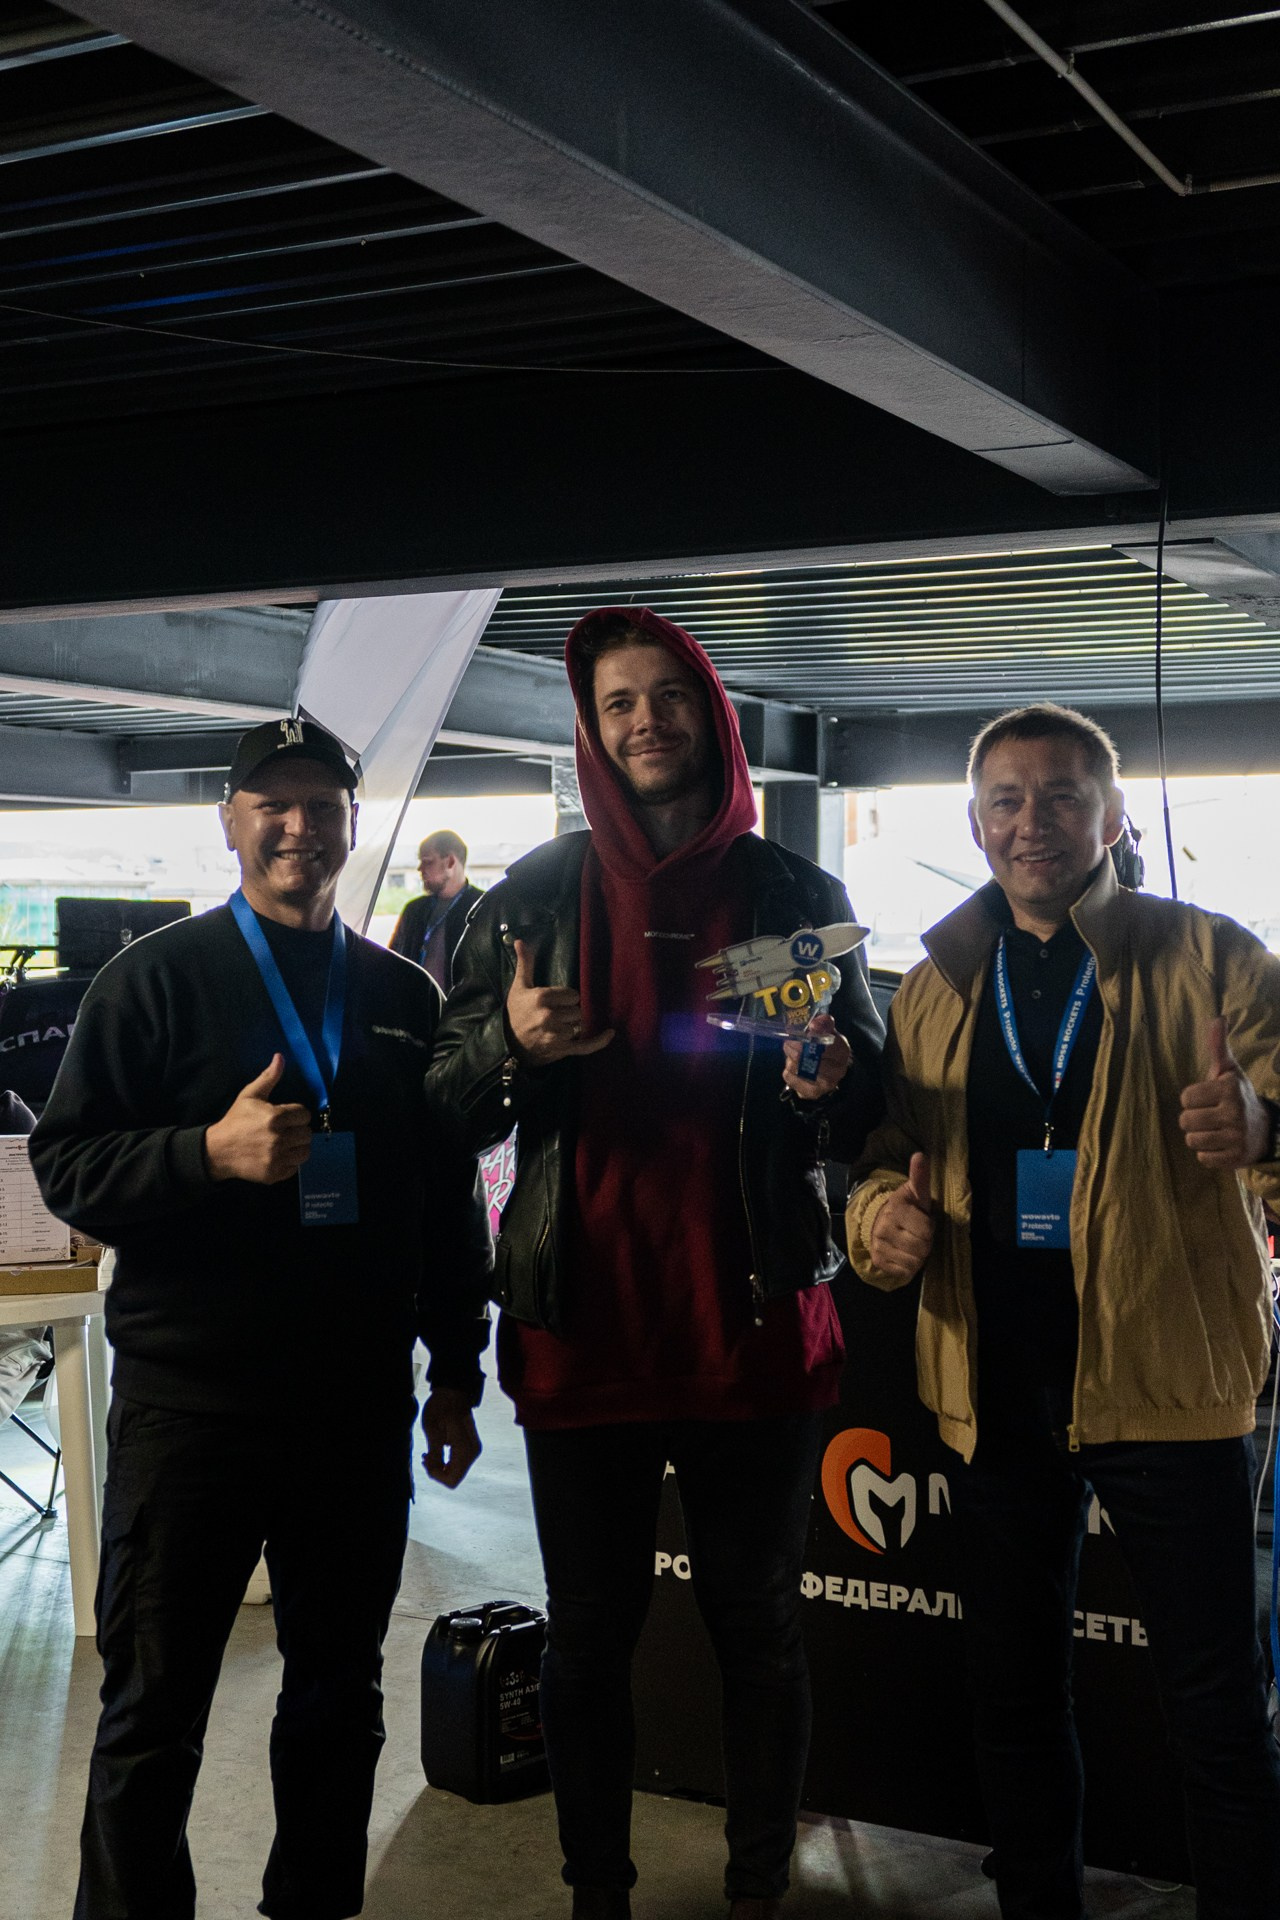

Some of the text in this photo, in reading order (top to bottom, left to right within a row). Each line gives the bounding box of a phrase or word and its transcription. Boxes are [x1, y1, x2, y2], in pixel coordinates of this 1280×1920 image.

[753, 969, 833, 1017] TOP
[1063, 1000, 1083, 1042] ROCKETS
[800, 1571, 963, 1620] ФЕДЕРАЛ
[499, 1688, 524, 1702] SYNTH
